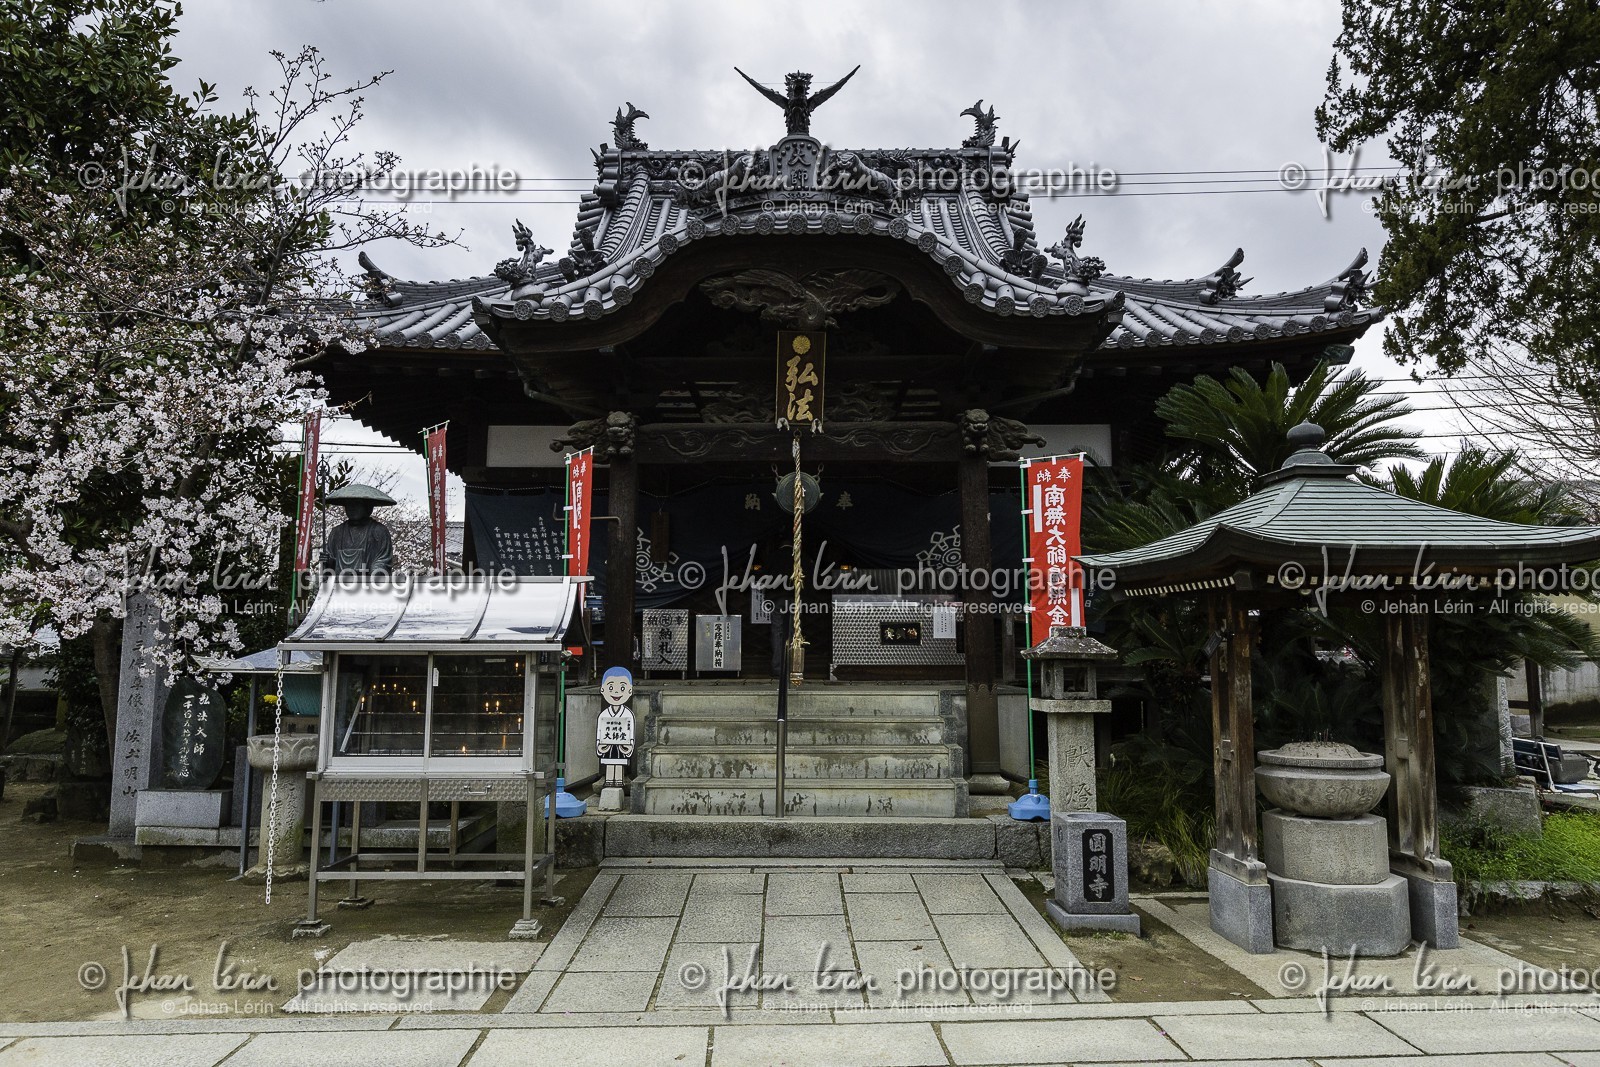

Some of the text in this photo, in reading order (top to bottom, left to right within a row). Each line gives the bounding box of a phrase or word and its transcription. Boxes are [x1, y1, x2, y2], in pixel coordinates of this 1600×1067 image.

[785, 355, 818, 421] 弘法
[657, 627, 672, 664] 納札入
